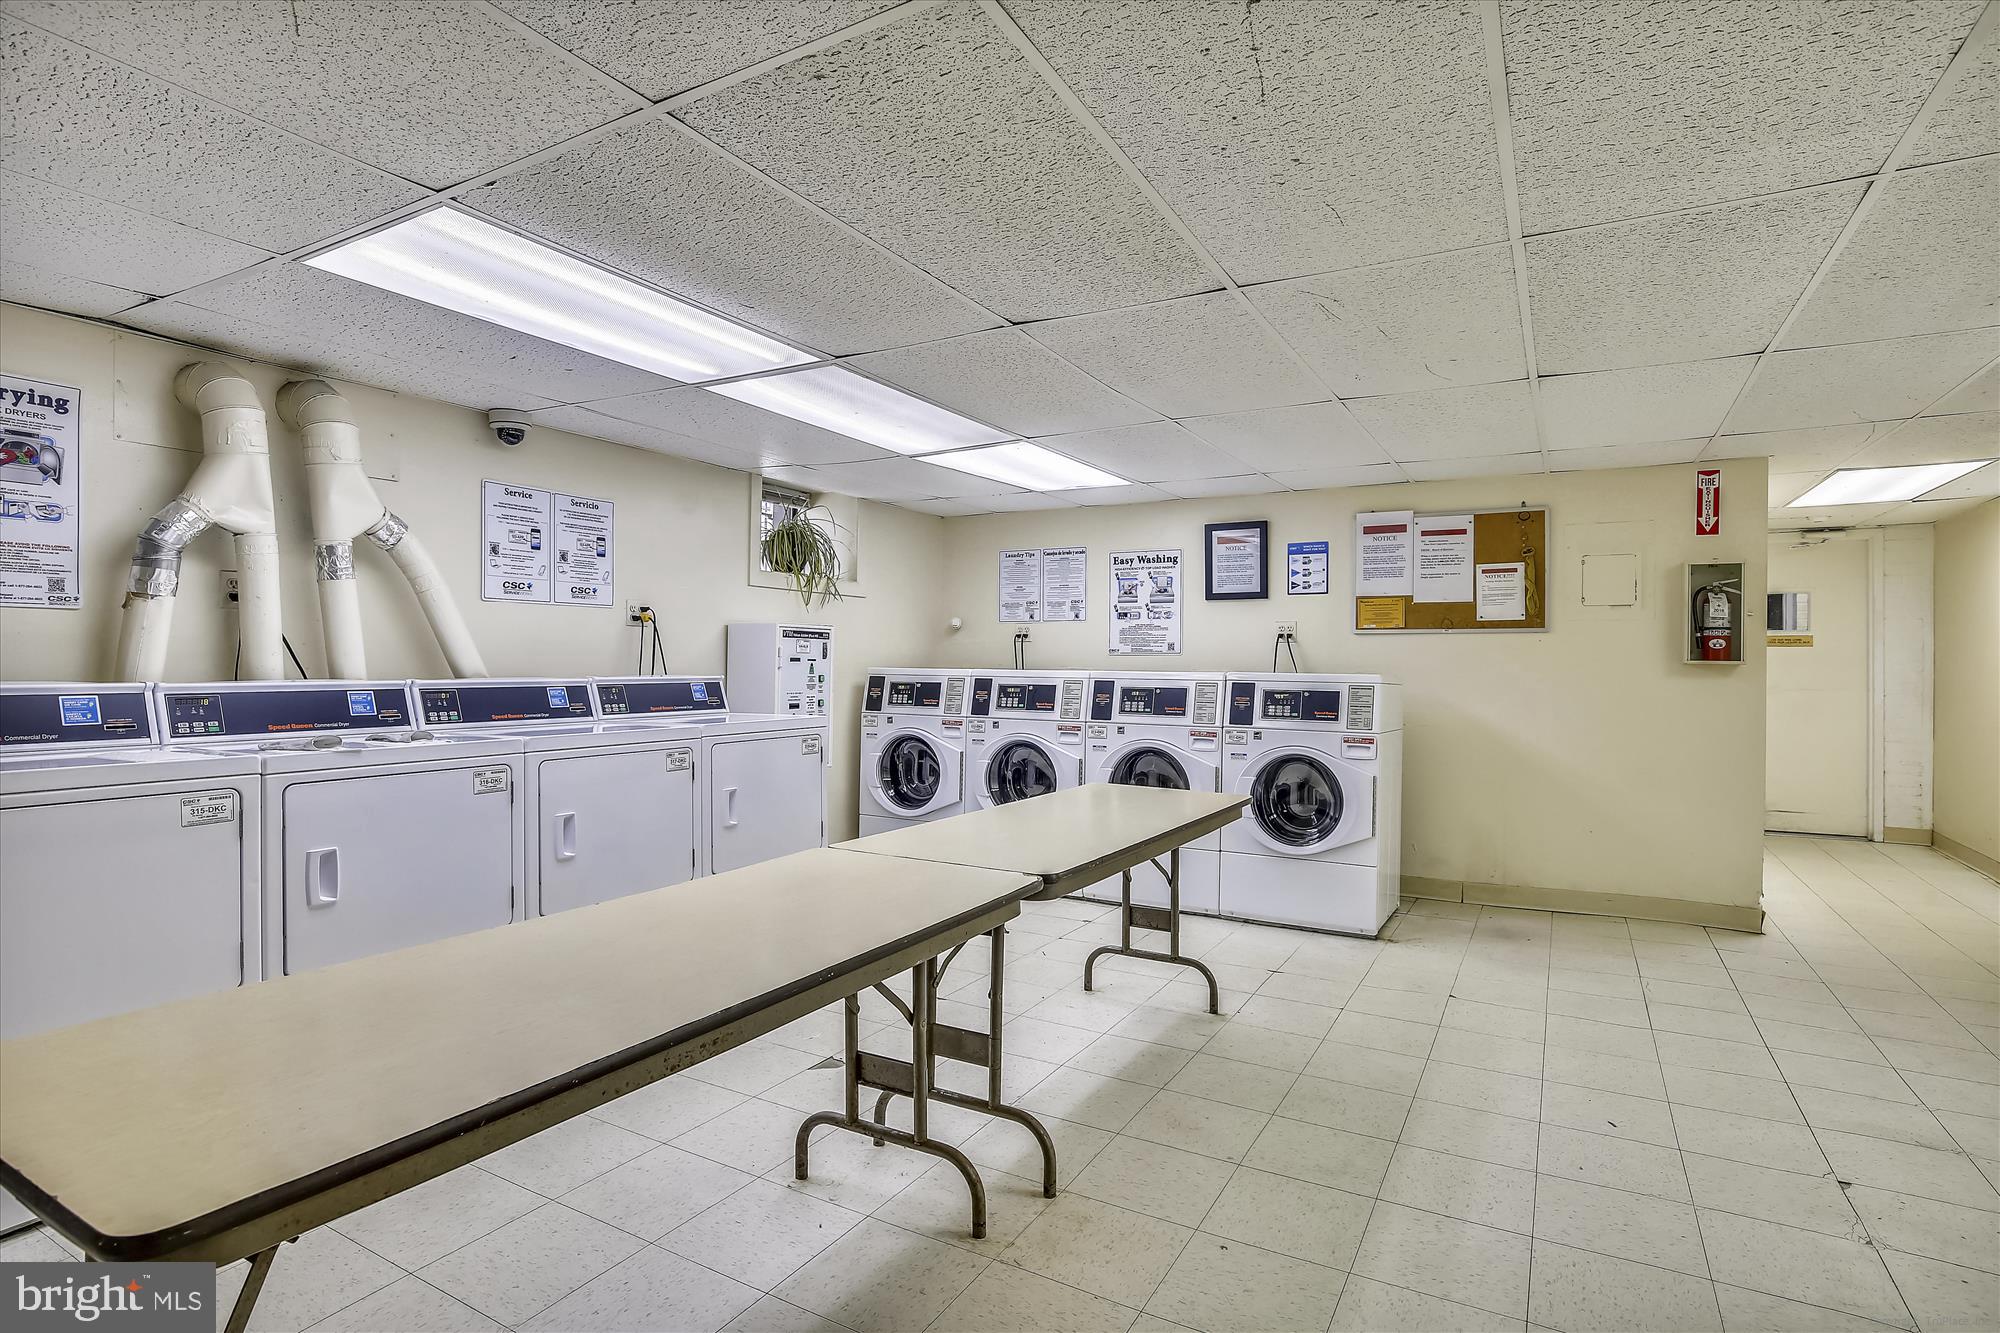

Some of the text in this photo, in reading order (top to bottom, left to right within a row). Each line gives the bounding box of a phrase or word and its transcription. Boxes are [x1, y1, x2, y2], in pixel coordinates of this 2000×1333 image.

[4, 408, 46, 420] DRYERS
[1700, 477, 1716, 486] FIRE
[504, 487, 533, 500] Service
[570, 498, 600, 510] Servicio
[1113, 554, 1178, 567] Easy Washing
[502, 581, 526, 590] CSC
[570, 586, 591, 595] CSC
[41, 733, 59, 741] Dryer
[190, 805, 227, 815] 315-DKC
